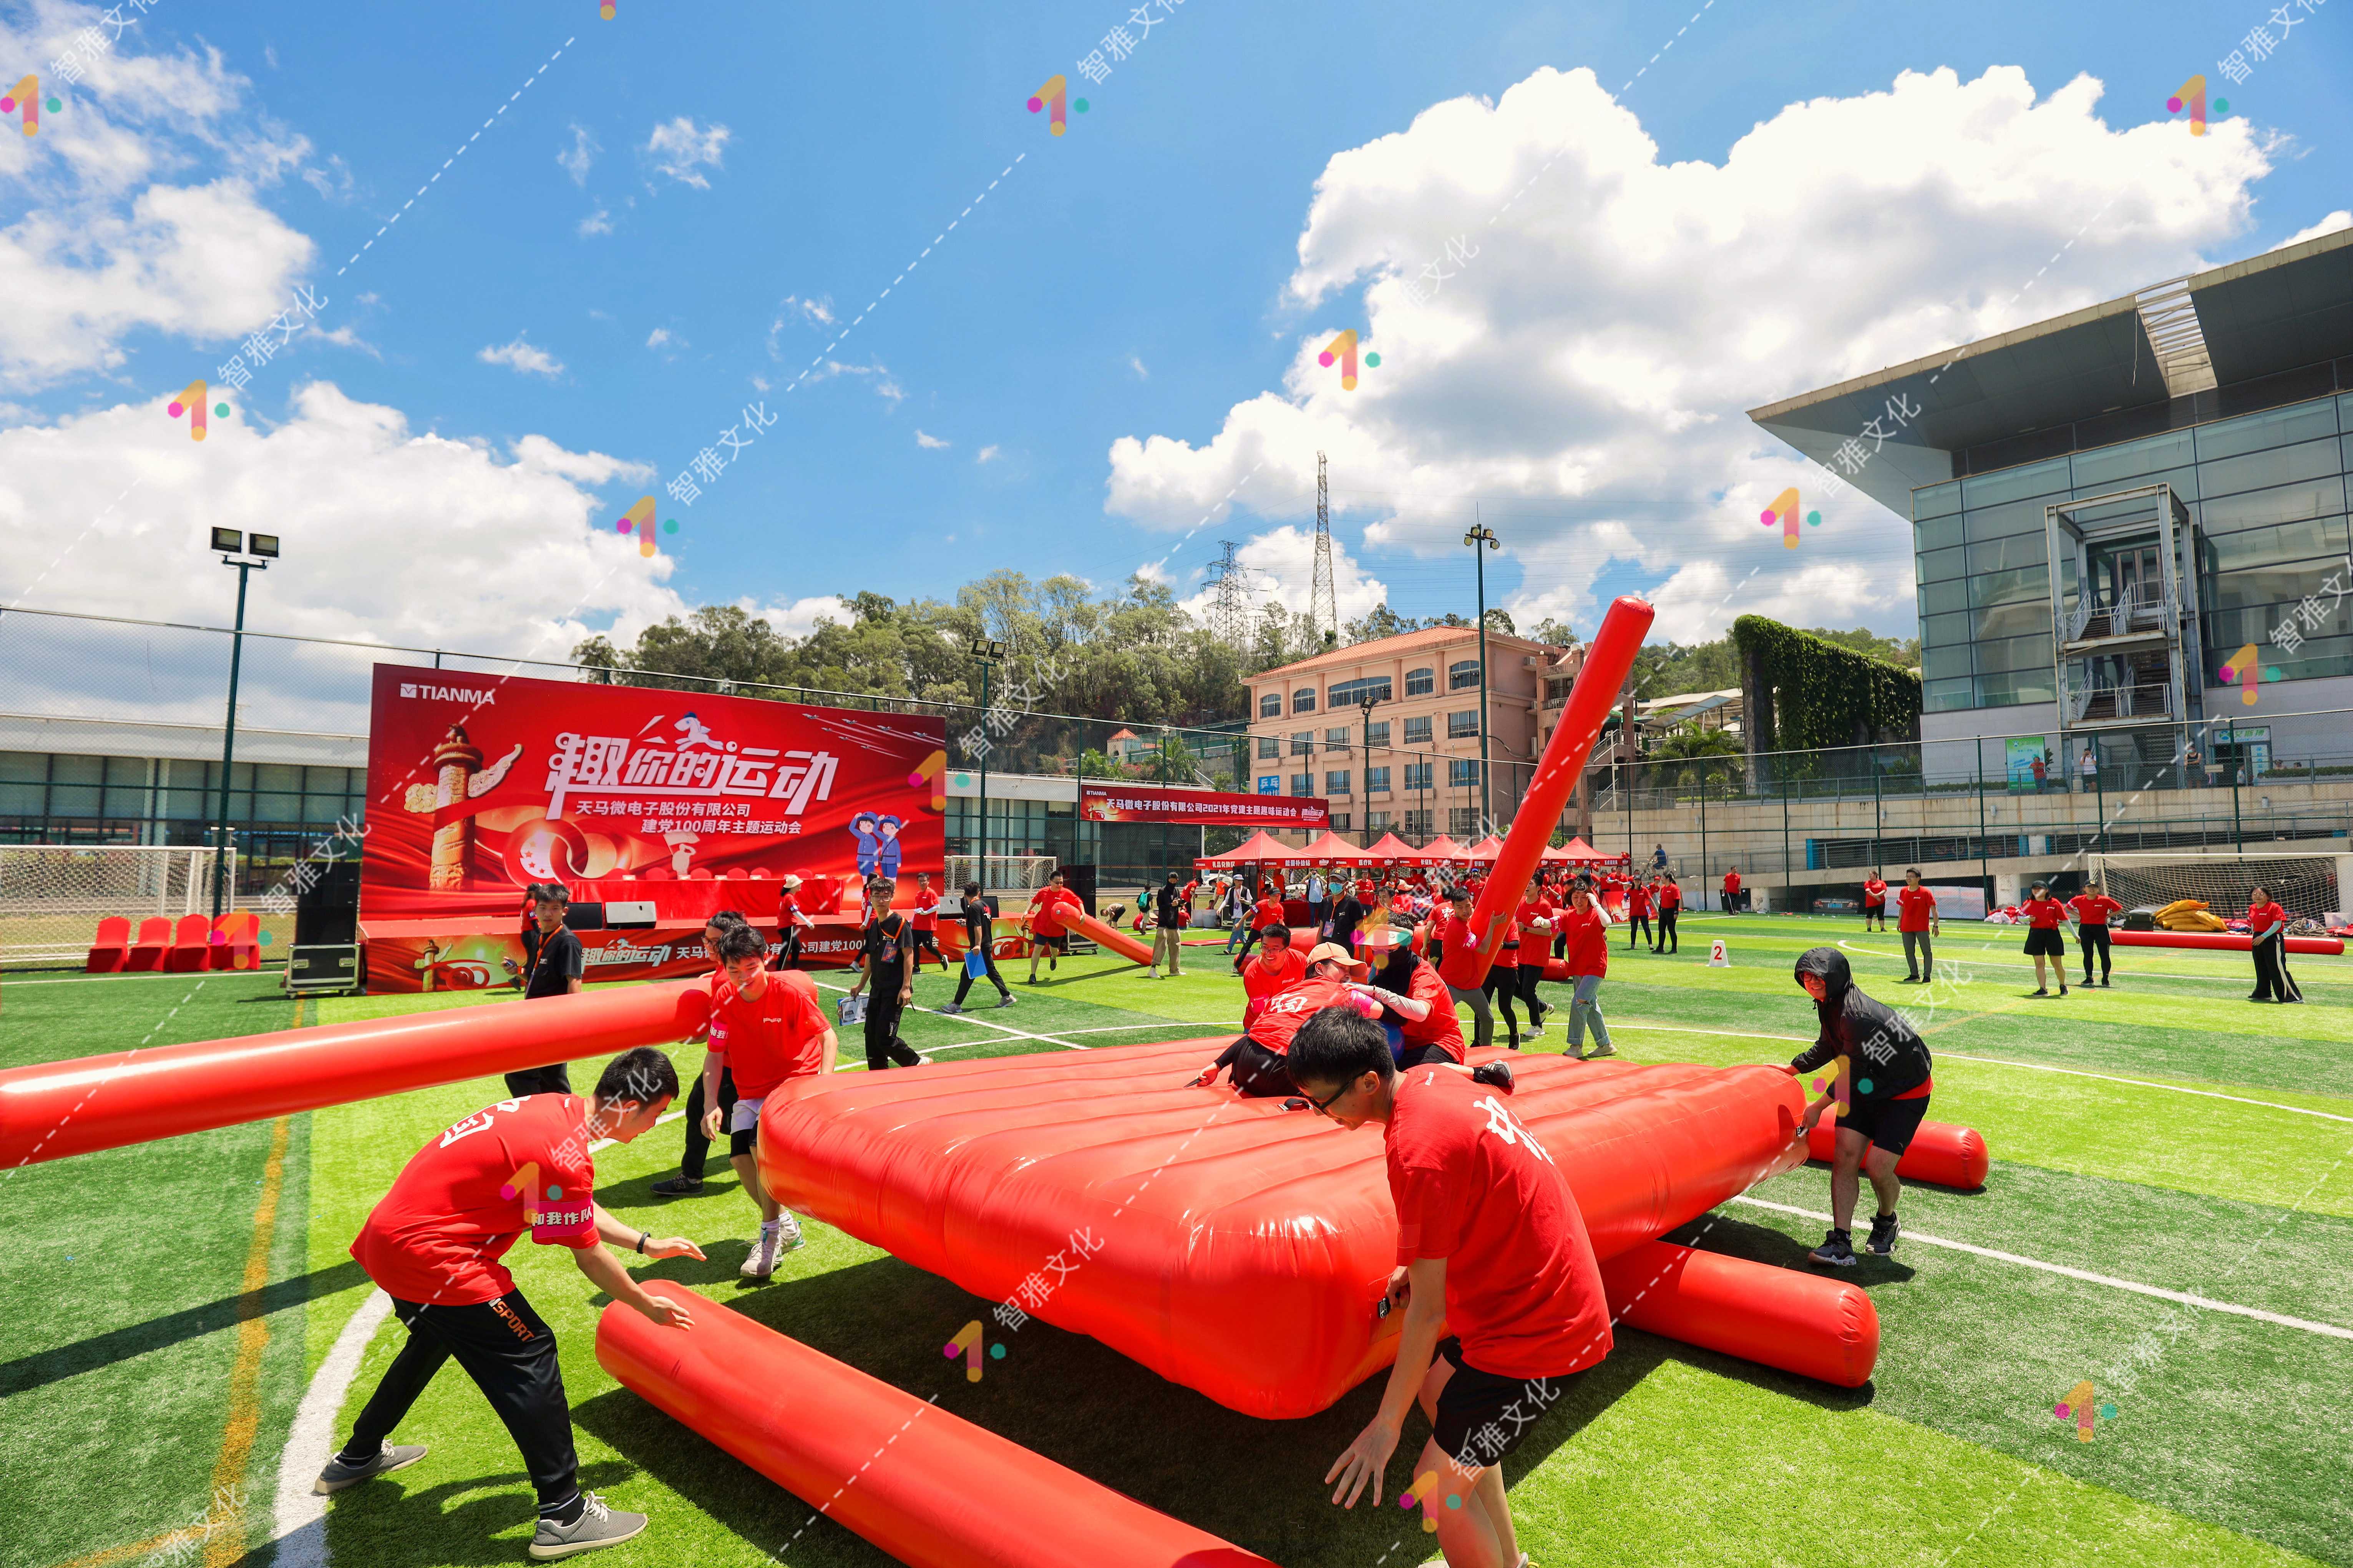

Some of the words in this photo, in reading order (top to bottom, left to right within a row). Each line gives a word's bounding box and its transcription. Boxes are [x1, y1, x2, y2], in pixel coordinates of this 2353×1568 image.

[419, 685, 495, 705] TIANMA
[576, 800, 751, 817] 天马微电子股份有限公司
[641, 819, 802, 835] 建党100周年主题运动会
[1714, 946, 1722, 960] 2
